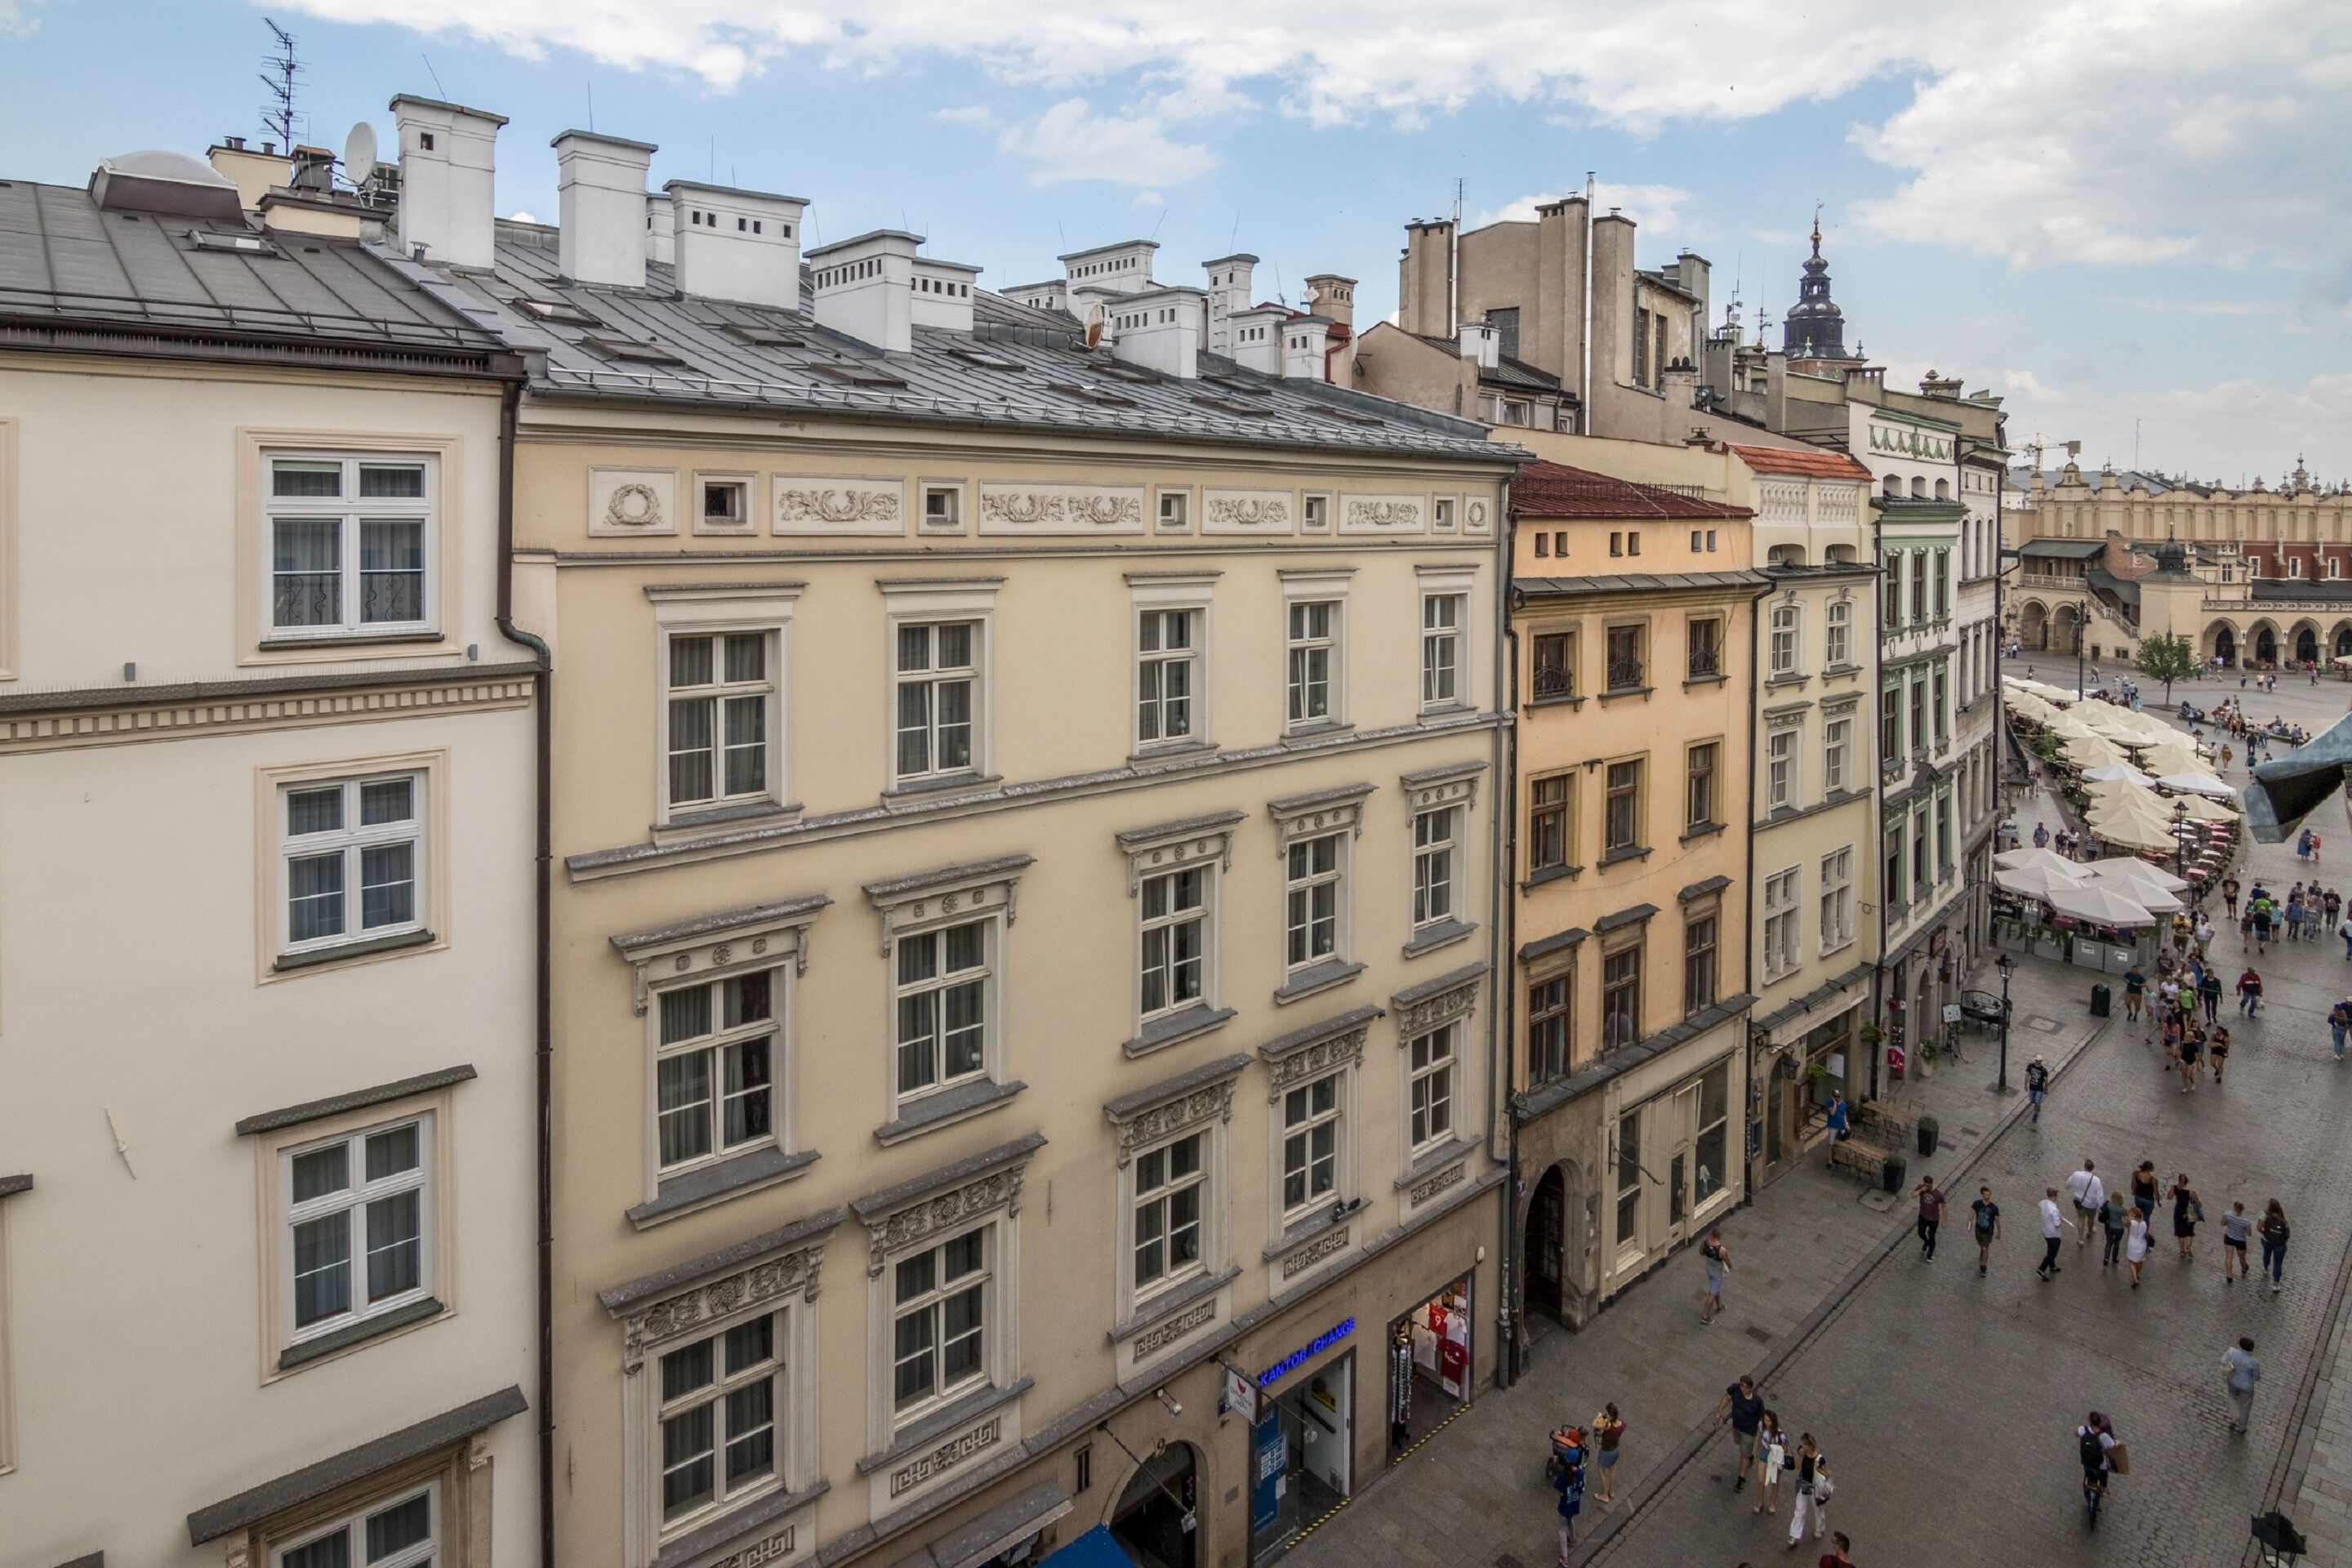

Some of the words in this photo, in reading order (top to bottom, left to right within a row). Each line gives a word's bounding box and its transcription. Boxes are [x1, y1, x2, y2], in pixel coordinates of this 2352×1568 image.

[1435, 1316, 1441, 1326] 9
[1258, 1348, 1307, 1387] KANTOR
[1312, 1317, 1355, 1353] CHANGE
